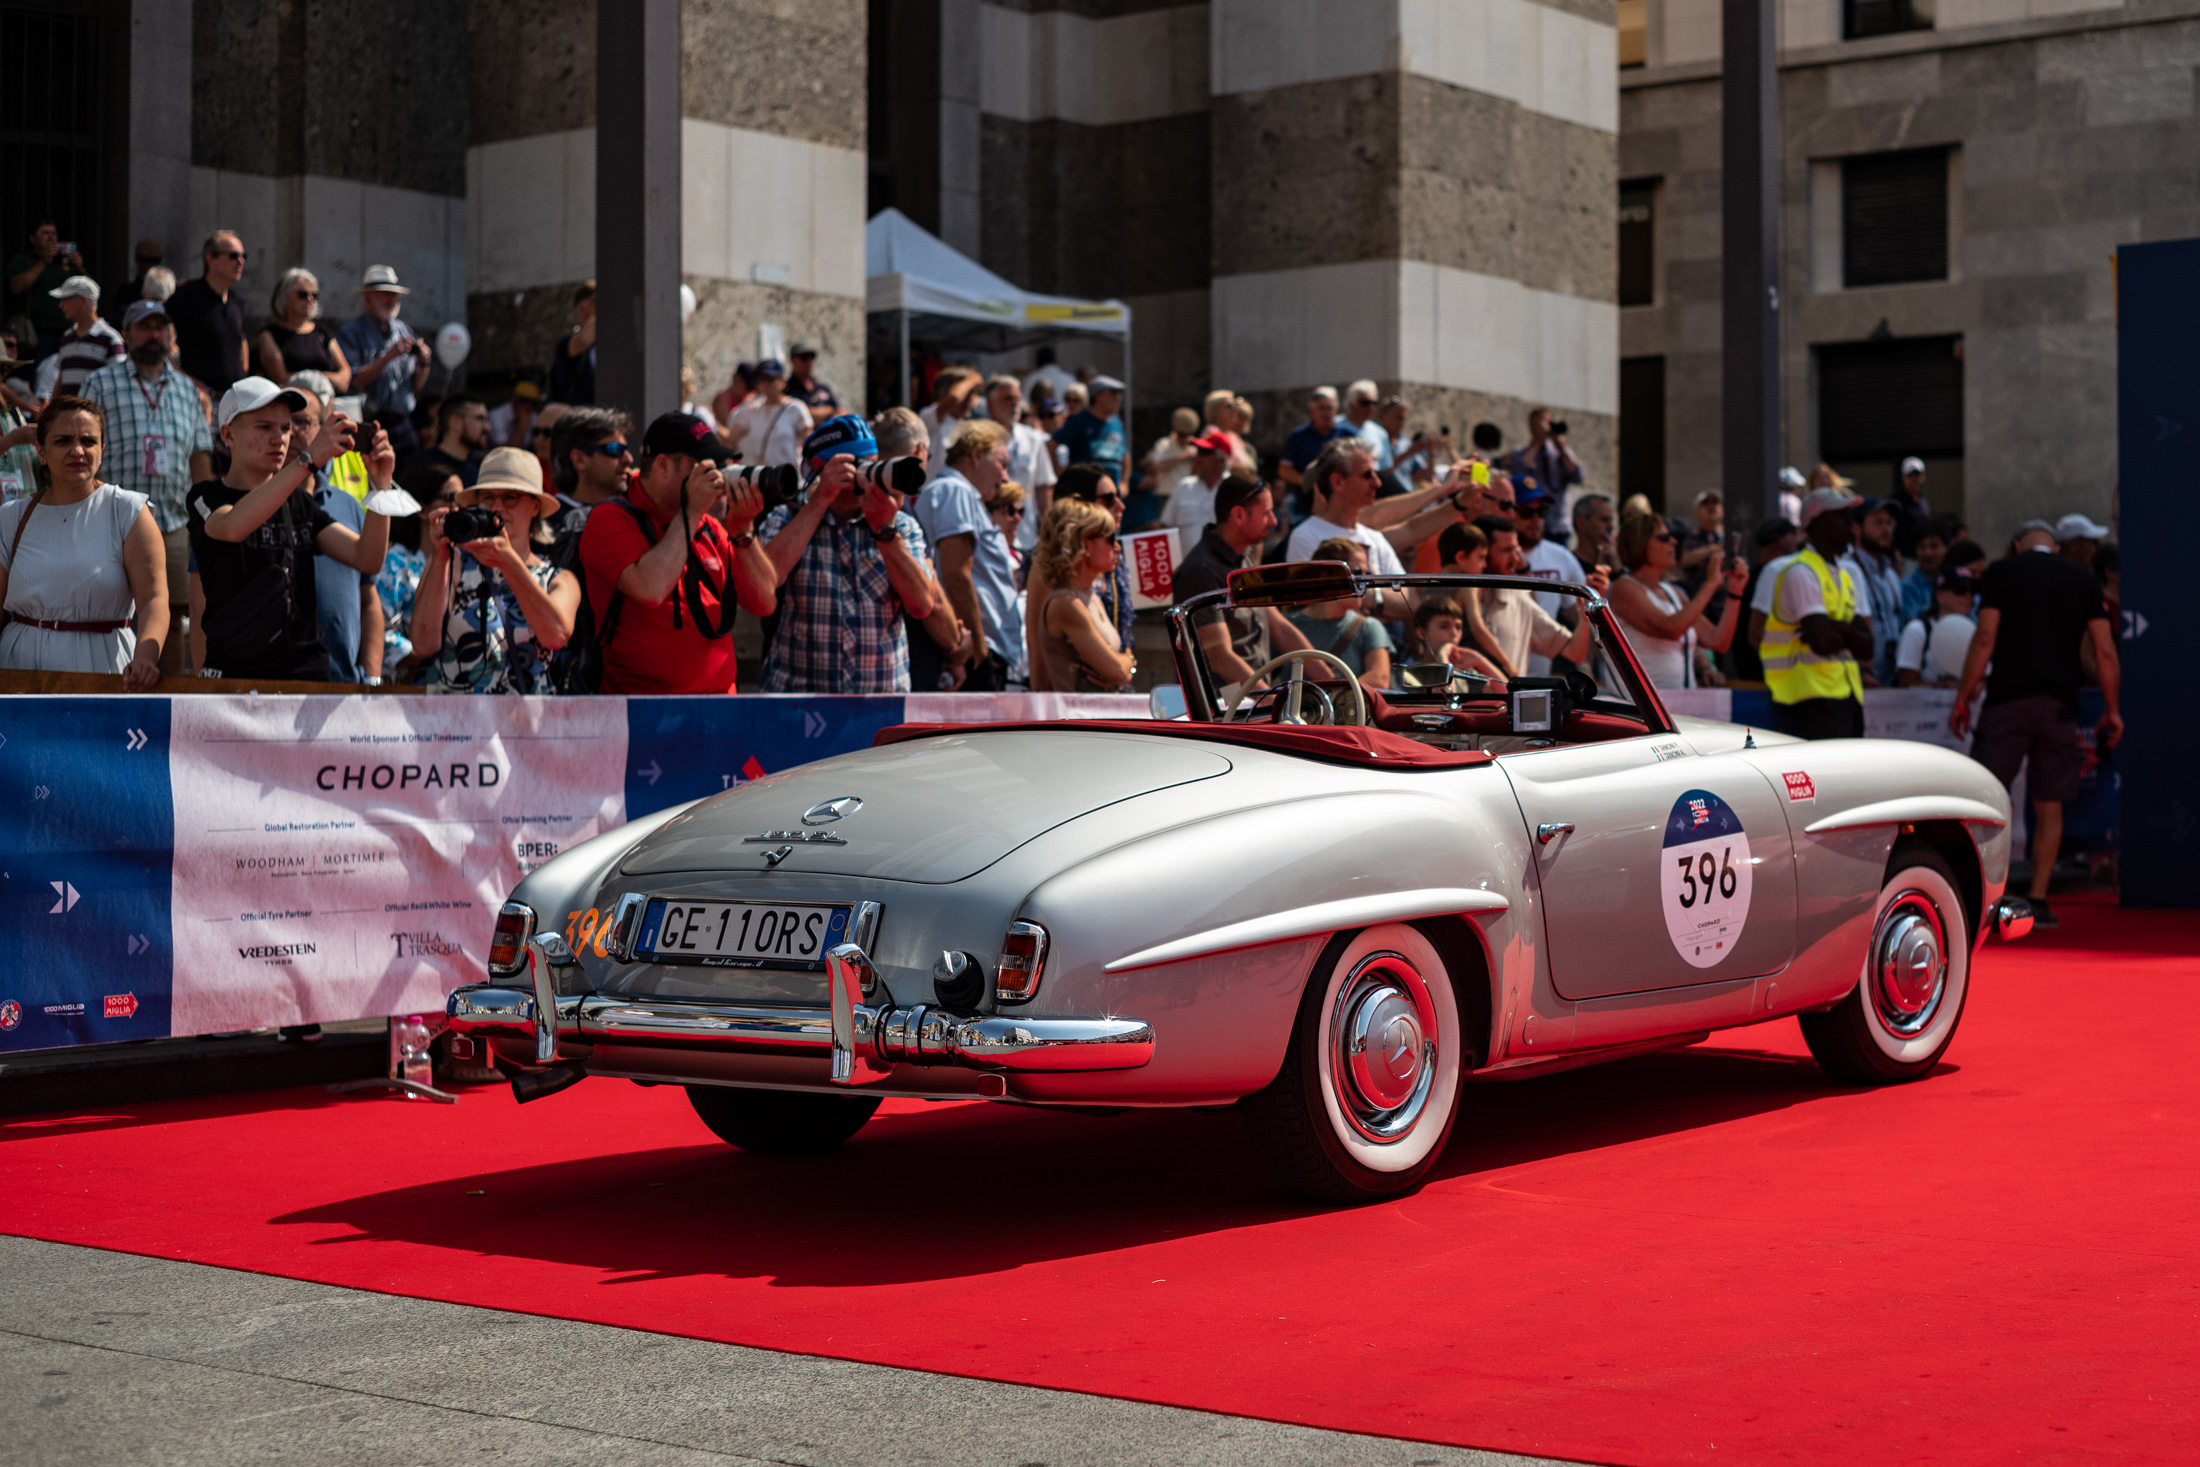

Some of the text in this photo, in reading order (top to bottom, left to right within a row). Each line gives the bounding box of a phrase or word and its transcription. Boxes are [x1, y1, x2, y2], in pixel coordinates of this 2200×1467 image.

[1136, 540, 1155, 591] MIGLIA
[1153, 540, 1172, 585] 1000
[350, 733, 473, 745] World Sponsor & Official Timekeeper
[316, 762, 501, 791] CHOPARD
[1785, 773, 1806, 785] 1000
[1790, 785, 1812, 798] MIGLIA
[548, 814, 573, 824] Partner
[264, 820, 355, 833] Global Restoration Partner
[235, 852, 385, 870] WOODHAM MORTIMER
[1678, 847, 1737, 909] 396
[385, 900, 472, 913] Official Red&White Wine
[240, 909, 312, 922] Official Tyre Partner
[660, 906, 706, 950] GE
[715, 908, 824, 955] 110RS
[407, 931, 441, 944] VILLA
[238, 942, 317, 959] VREDESTEIN
[408, 942, 464, 957] TRASQUA
[107, 996, 130, 1006] 1000
[106, 1005, 131, 1015] MIGLIA
